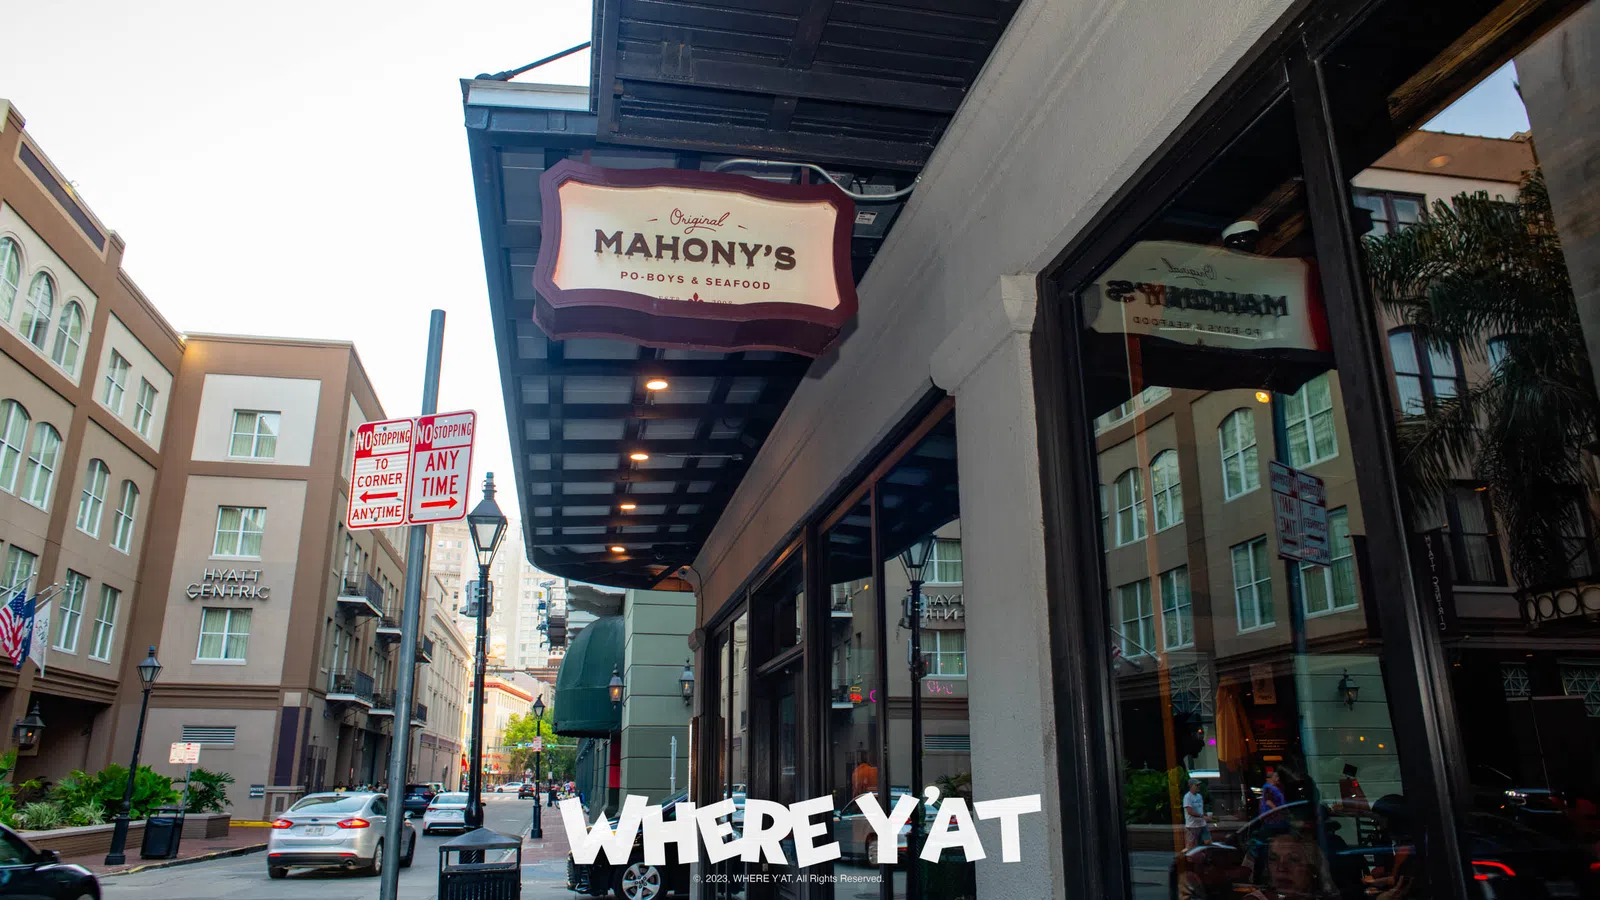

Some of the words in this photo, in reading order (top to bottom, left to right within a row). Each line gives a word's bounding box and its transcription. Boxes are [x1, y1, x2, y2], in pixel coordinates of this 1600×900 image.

[670, 208, 730, 234] Original
[594, 229, 796, 270] MAHONY'S
[620, 271, 685, 284] PO-BOYS
[691, 276, 699, 285] &
[705, 277, 771, 290] SEAFOOD
[356, 431, 373, 452] NO
[372, 430, 410, 447] STOPPING
[416, 423, 434, 445] NO
[433, 422, 472, 440] STOPPING
[375, 458, 389, 470] TO
[425, 450, 460, 472] ANY
[357, 473, 403, 488] CORNER
[421, 475, 459, 497] TIME
[352, 506, 402, 520] ANYTIME
[203, 568, 263, 583] HYATT
[186, 583, 270, 599] CENTRIC
